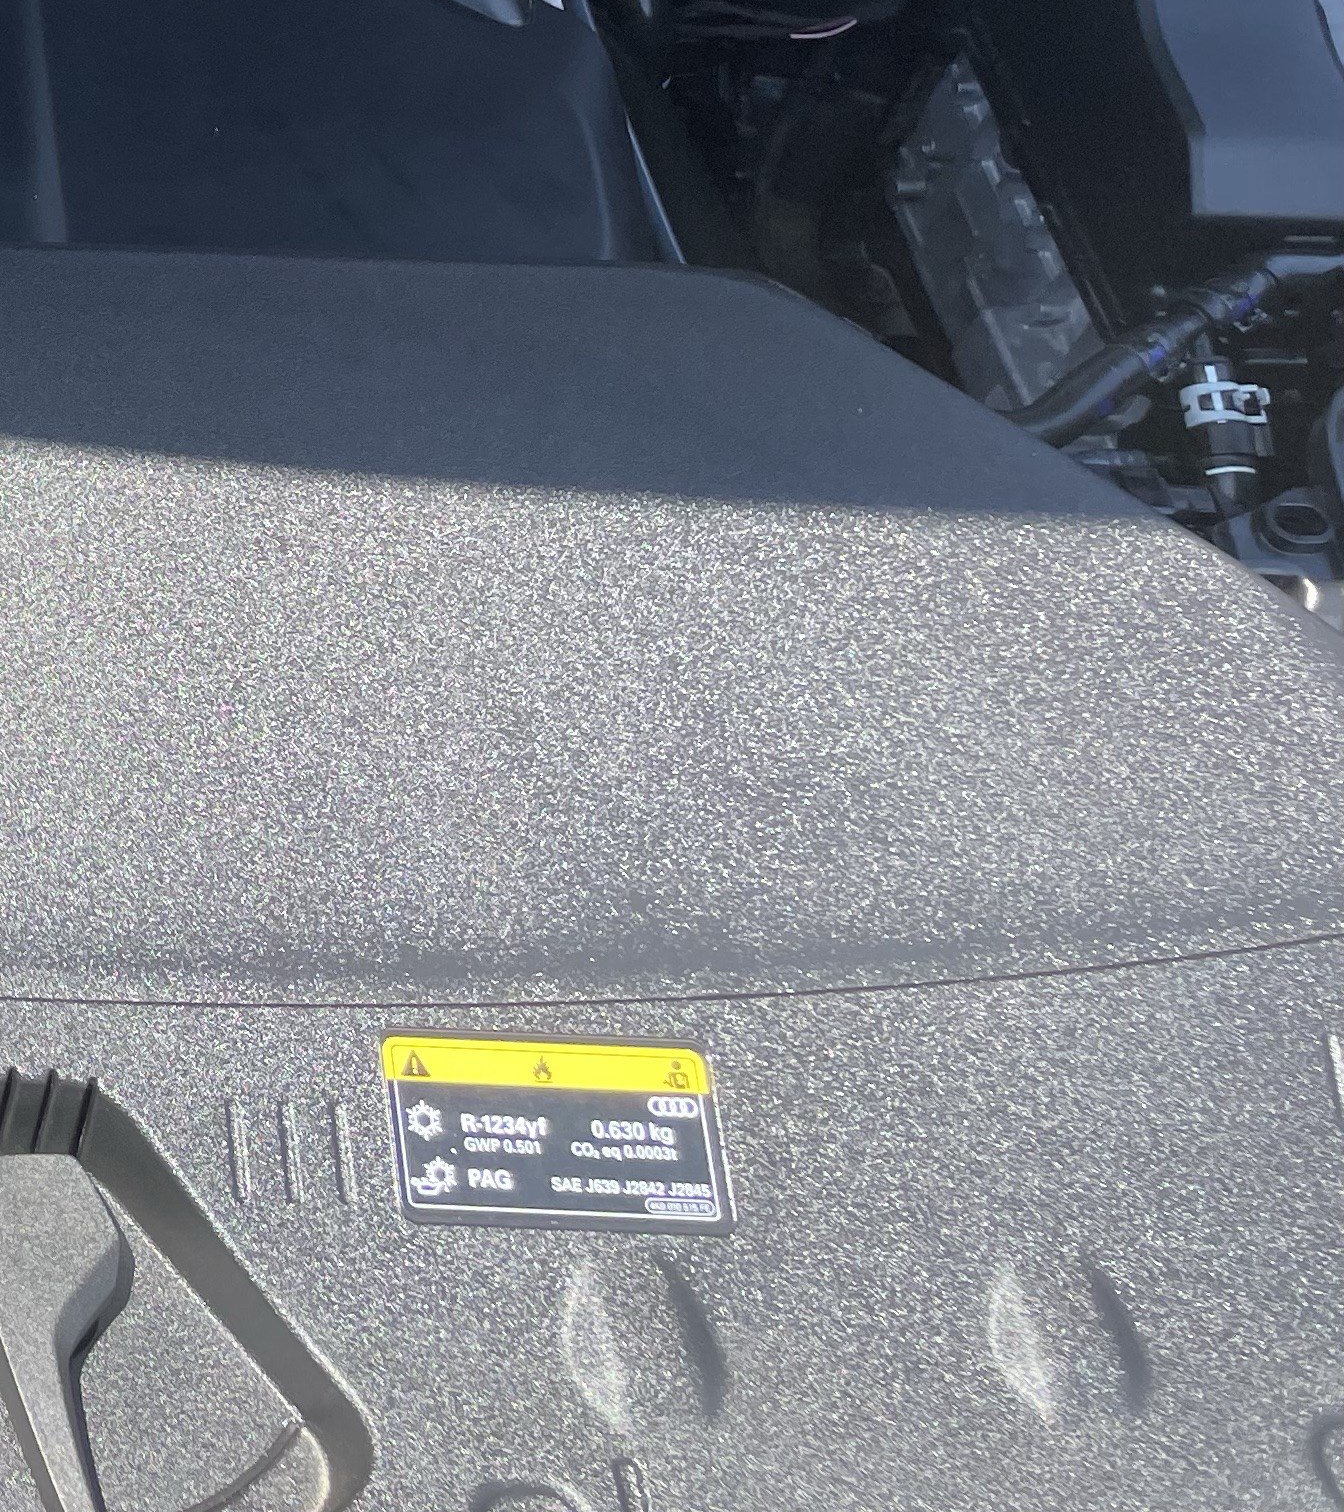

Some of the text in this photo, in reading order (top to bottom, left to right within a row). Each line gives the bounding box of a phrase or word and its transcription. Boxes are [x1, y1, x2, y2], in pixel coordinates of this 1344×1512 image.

[460, 1112, 675, 1146] R-1234yf 0.630 kg
[463, 1136, 501, 1154] GWP
[503, 1139, 543, 1155] 0.501
[602, 1146, 623, 1162] eq
[624, 1144, 679, 1161] 0.0003t
[467, 1168, 712, 1199] PAG SAE J639 J2842 J2845
